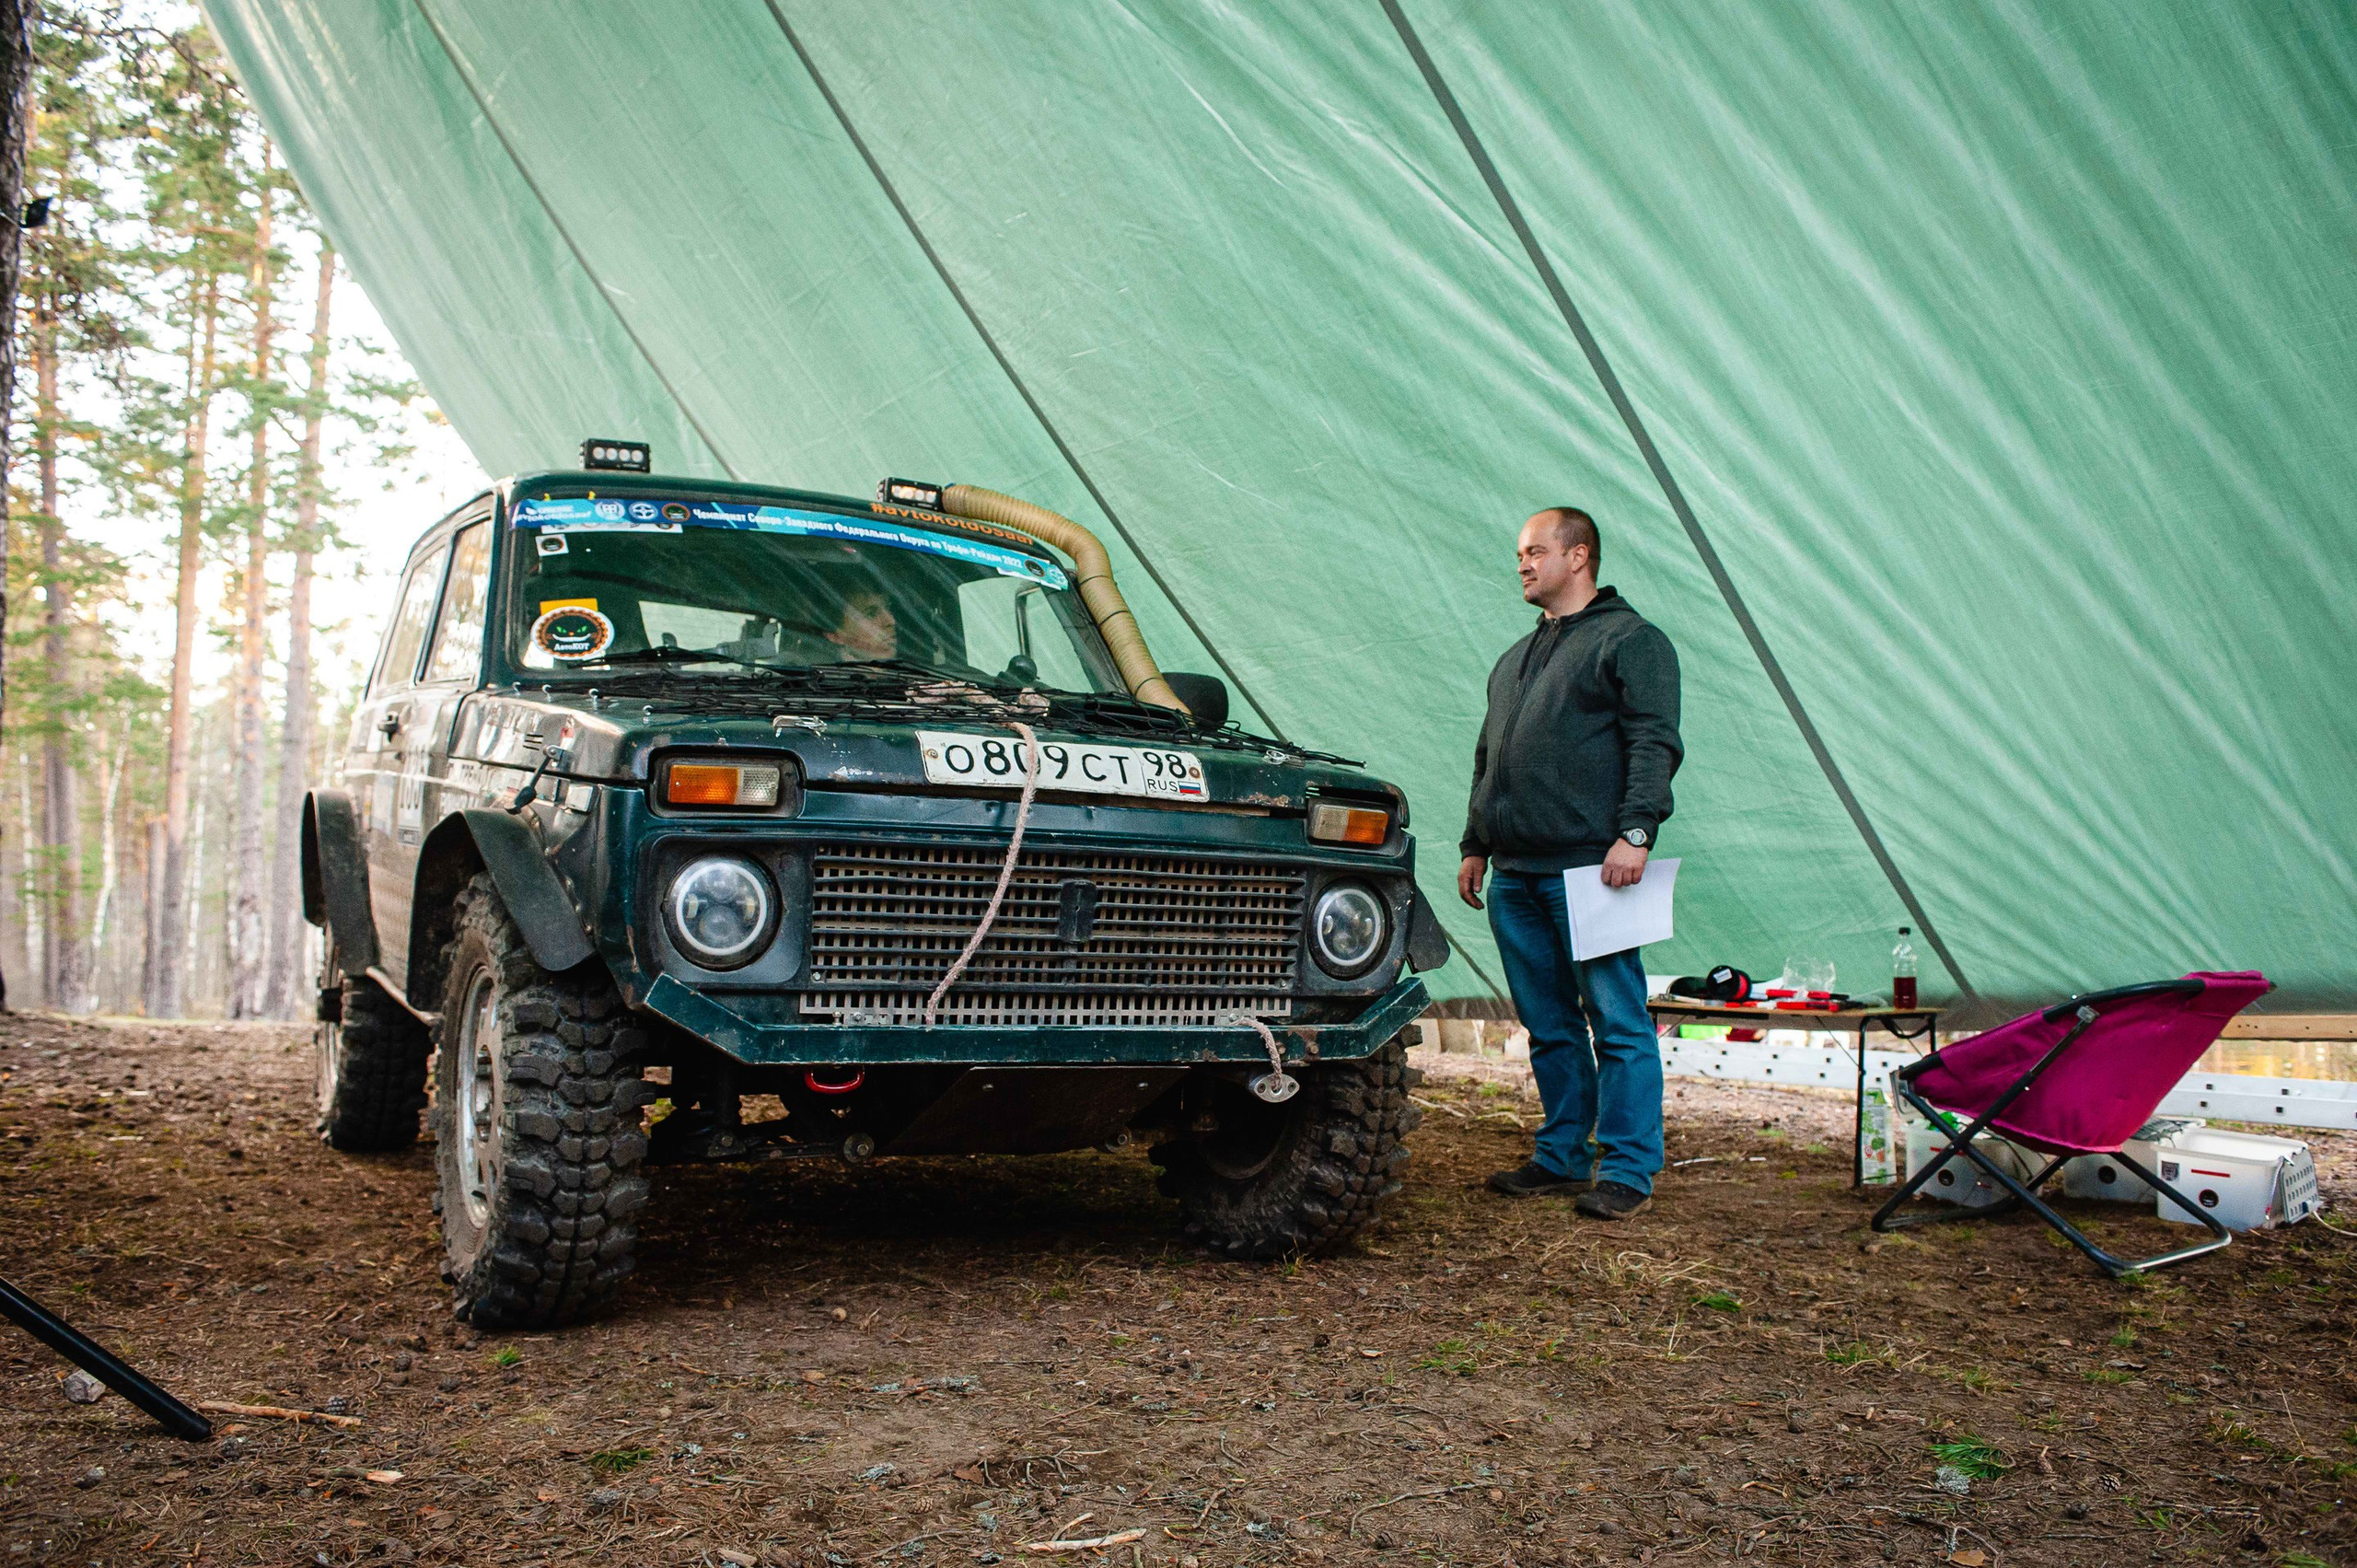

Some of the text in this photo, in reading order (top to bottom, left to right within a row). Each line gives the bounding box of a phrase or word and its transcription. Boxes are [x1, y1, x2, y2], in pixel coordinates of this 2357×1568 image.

[692, 508, 747, 522] Чемпионат
[748, 512, 834, 531] Северо-Западного
[834, 522, 900, 541] Федерального
[900, 532, 931, 547] Округа
[930, 540, 942, 550] по
[553, 642, 590, 652] АвтоКОТ
[1143, 750, 1188, 780] 98
[1148, 778, 1178, 792] RUS
